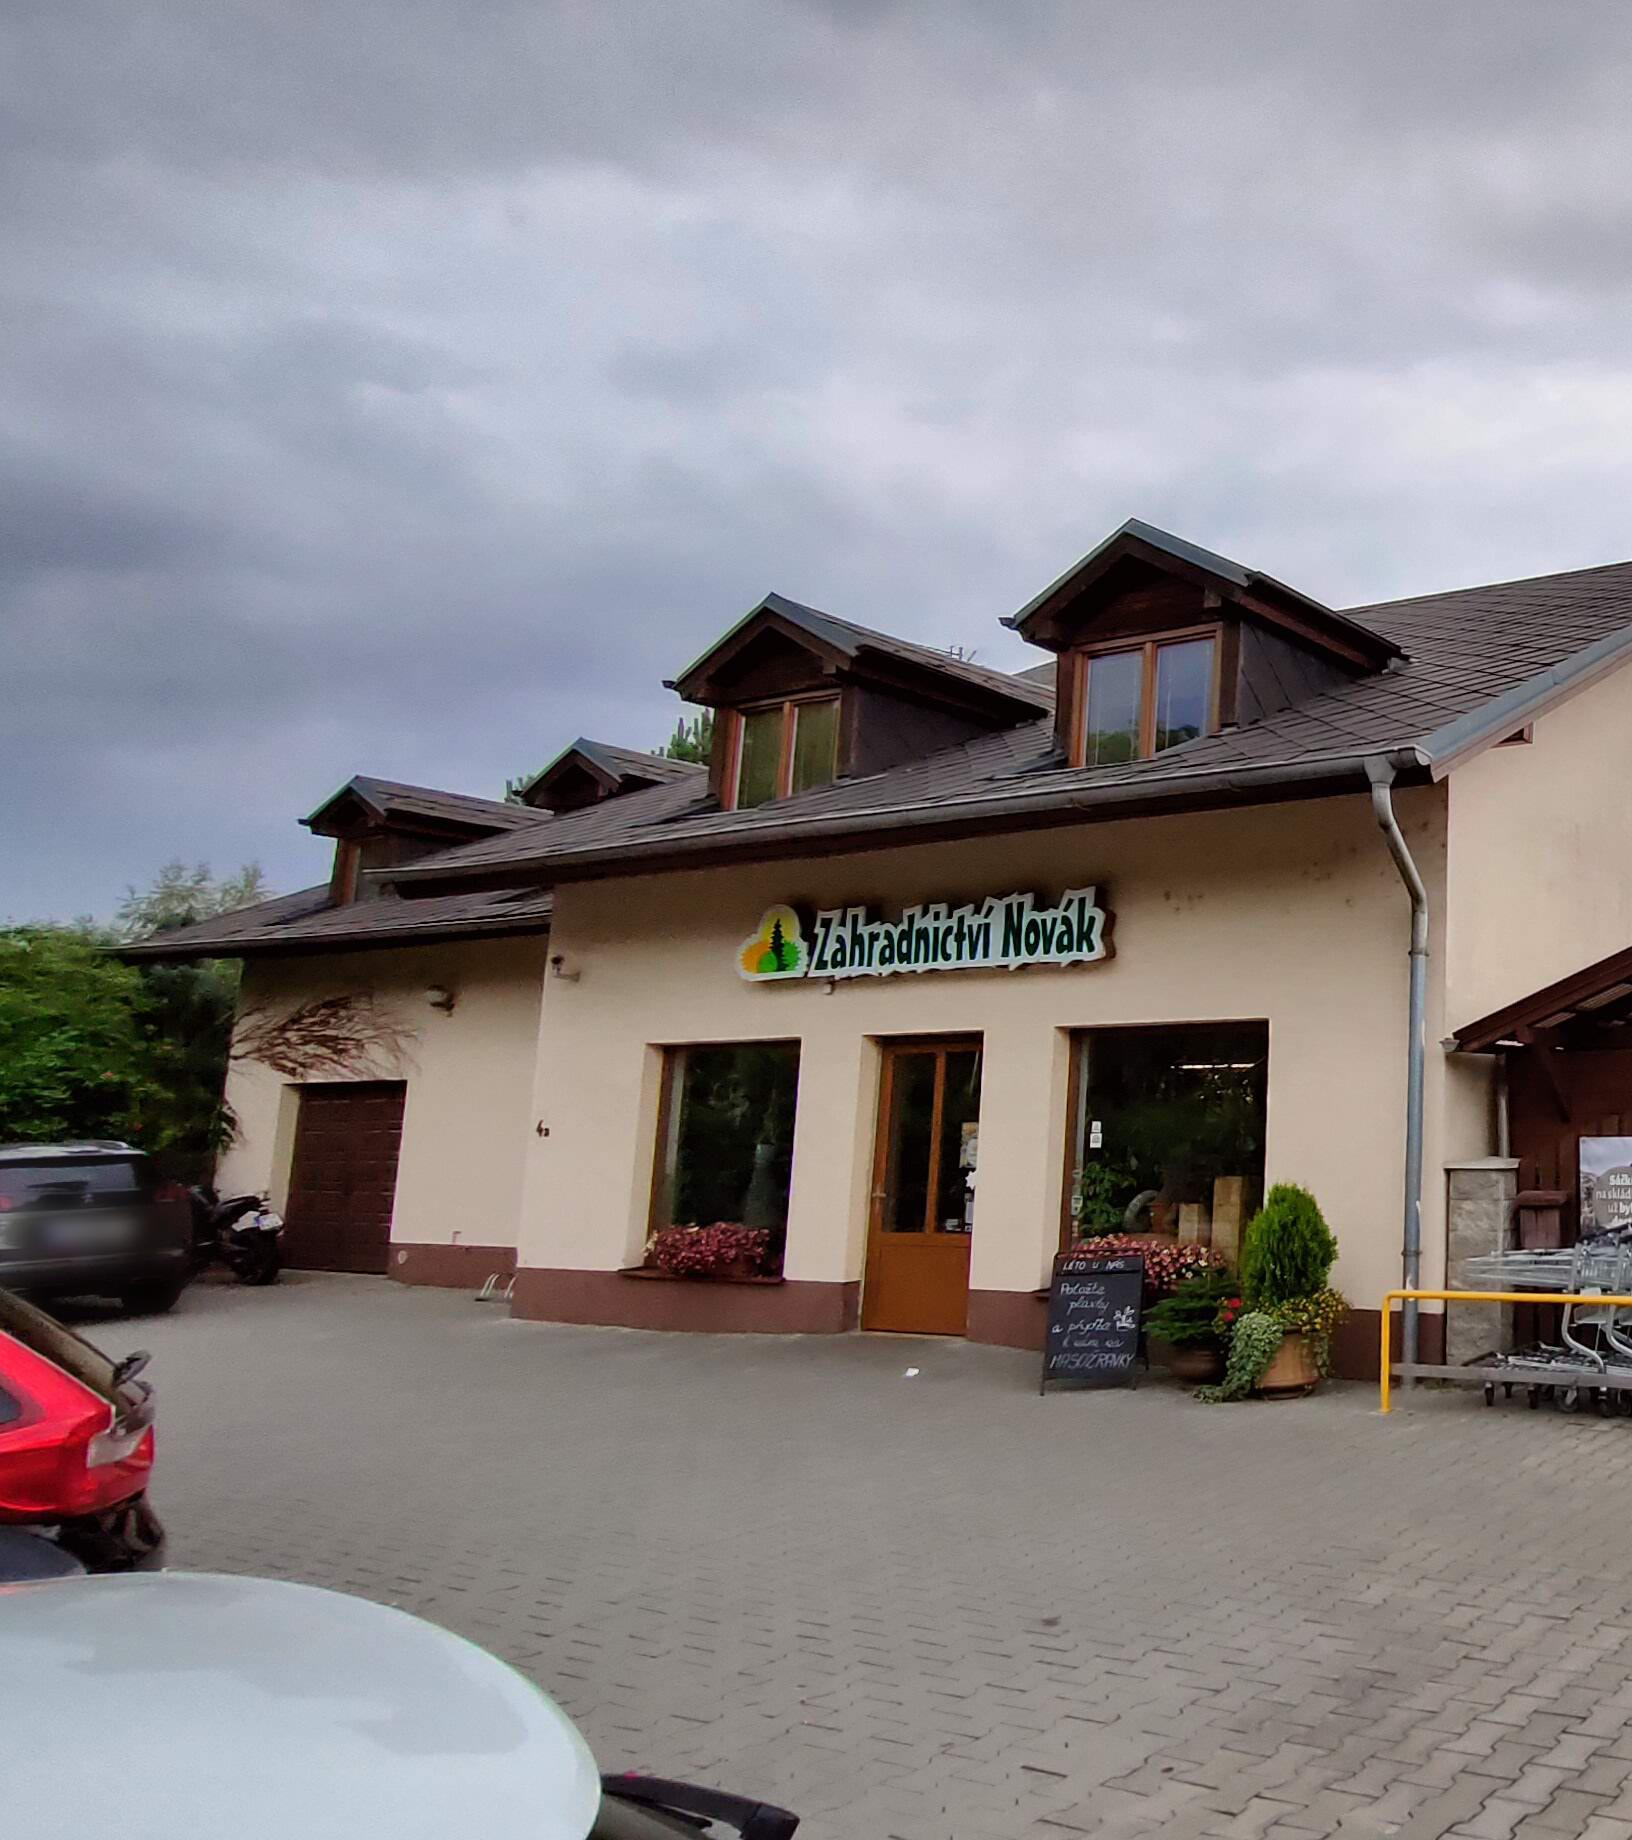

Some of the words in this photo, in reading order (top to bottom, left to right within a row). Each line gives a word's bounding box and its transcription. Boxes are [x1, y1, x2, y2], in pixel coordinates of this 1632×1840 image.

[814, 904, 994, 971] Zahradnictví
[1001, 895, 1097, 958] Novák
[1596, 1191, 1606, 1199] na
[1052, 1324, 1064, 1334] a
